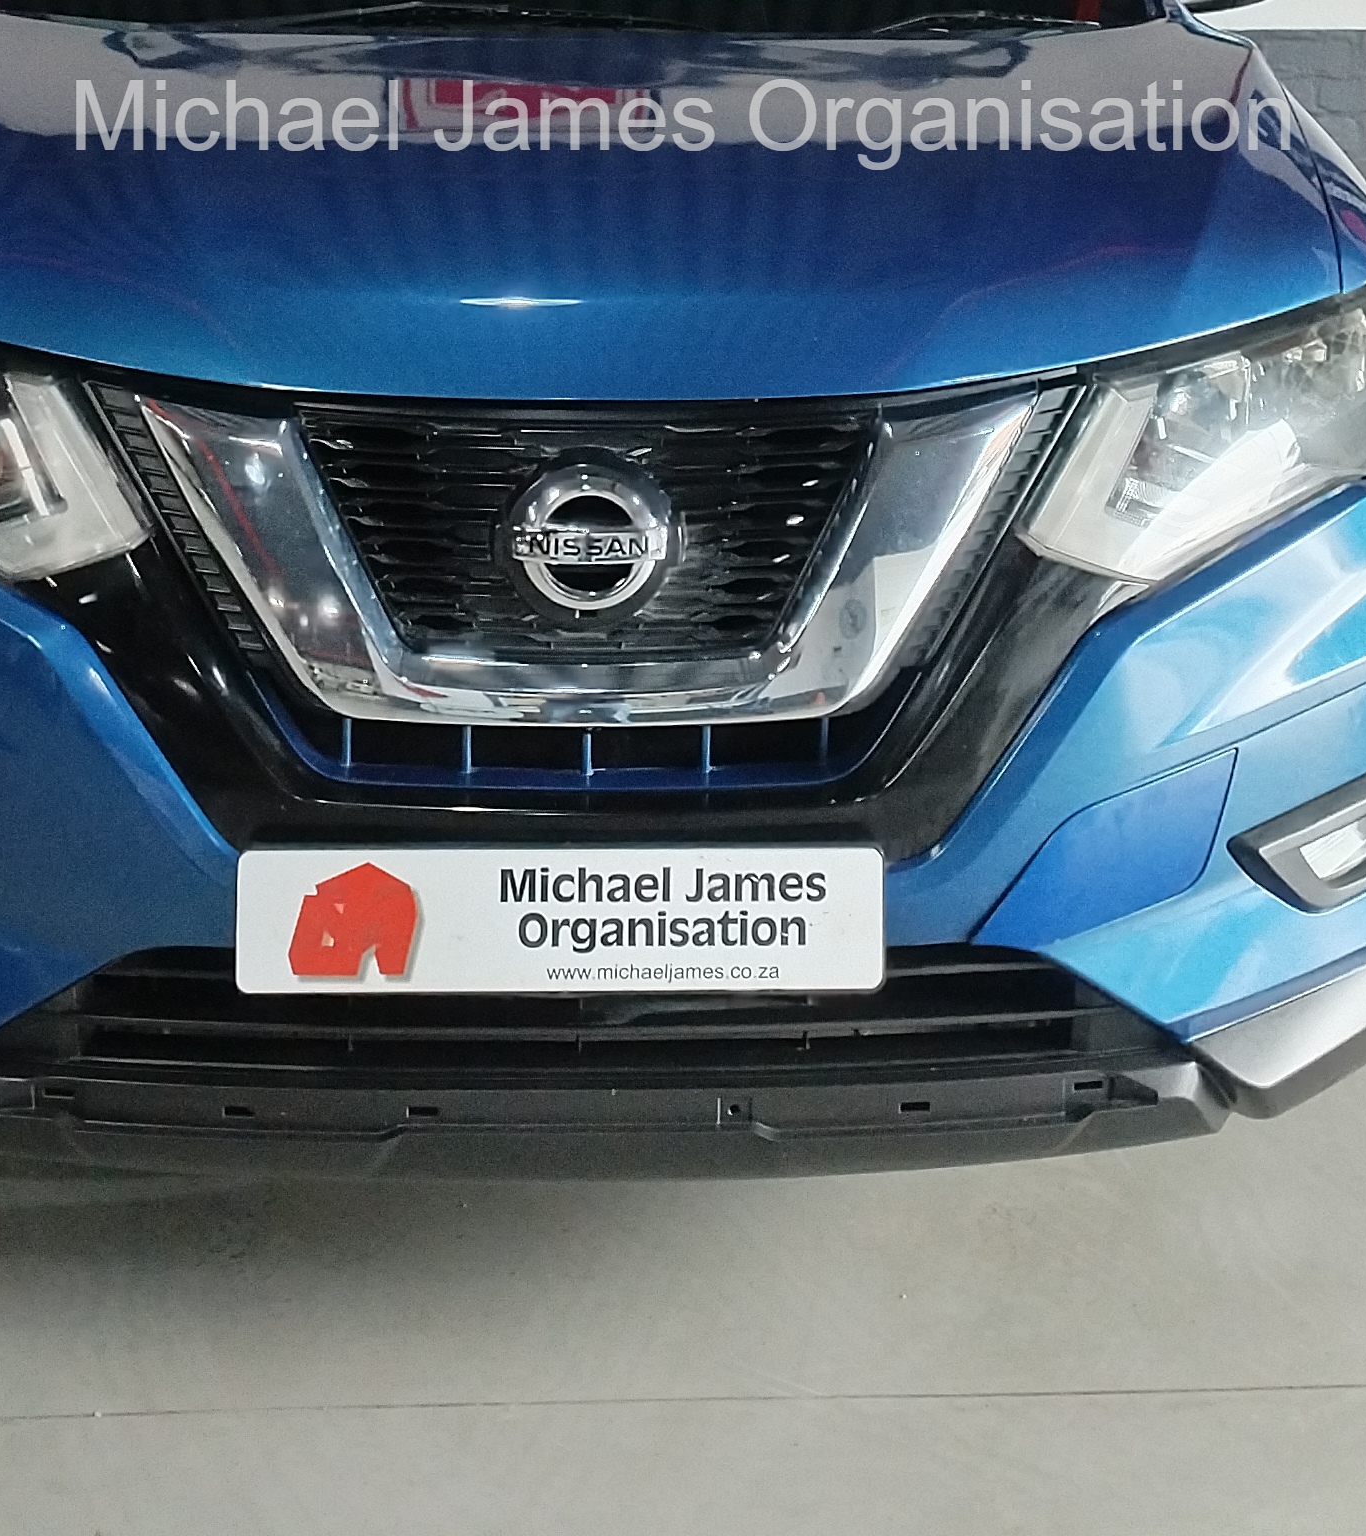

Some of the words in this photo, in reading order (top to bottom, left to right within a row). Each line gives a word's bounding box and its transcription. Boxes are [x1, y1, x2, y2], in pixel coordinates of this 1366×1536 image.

[529, 536, 649, 557] NISSAN
[498, 866, 672, 904] Michael
[685, 867, 827, 904] James
[517, 910, 808, 953] Organisation
[546, 963, 781, 985] www.michaeljames.co.za
